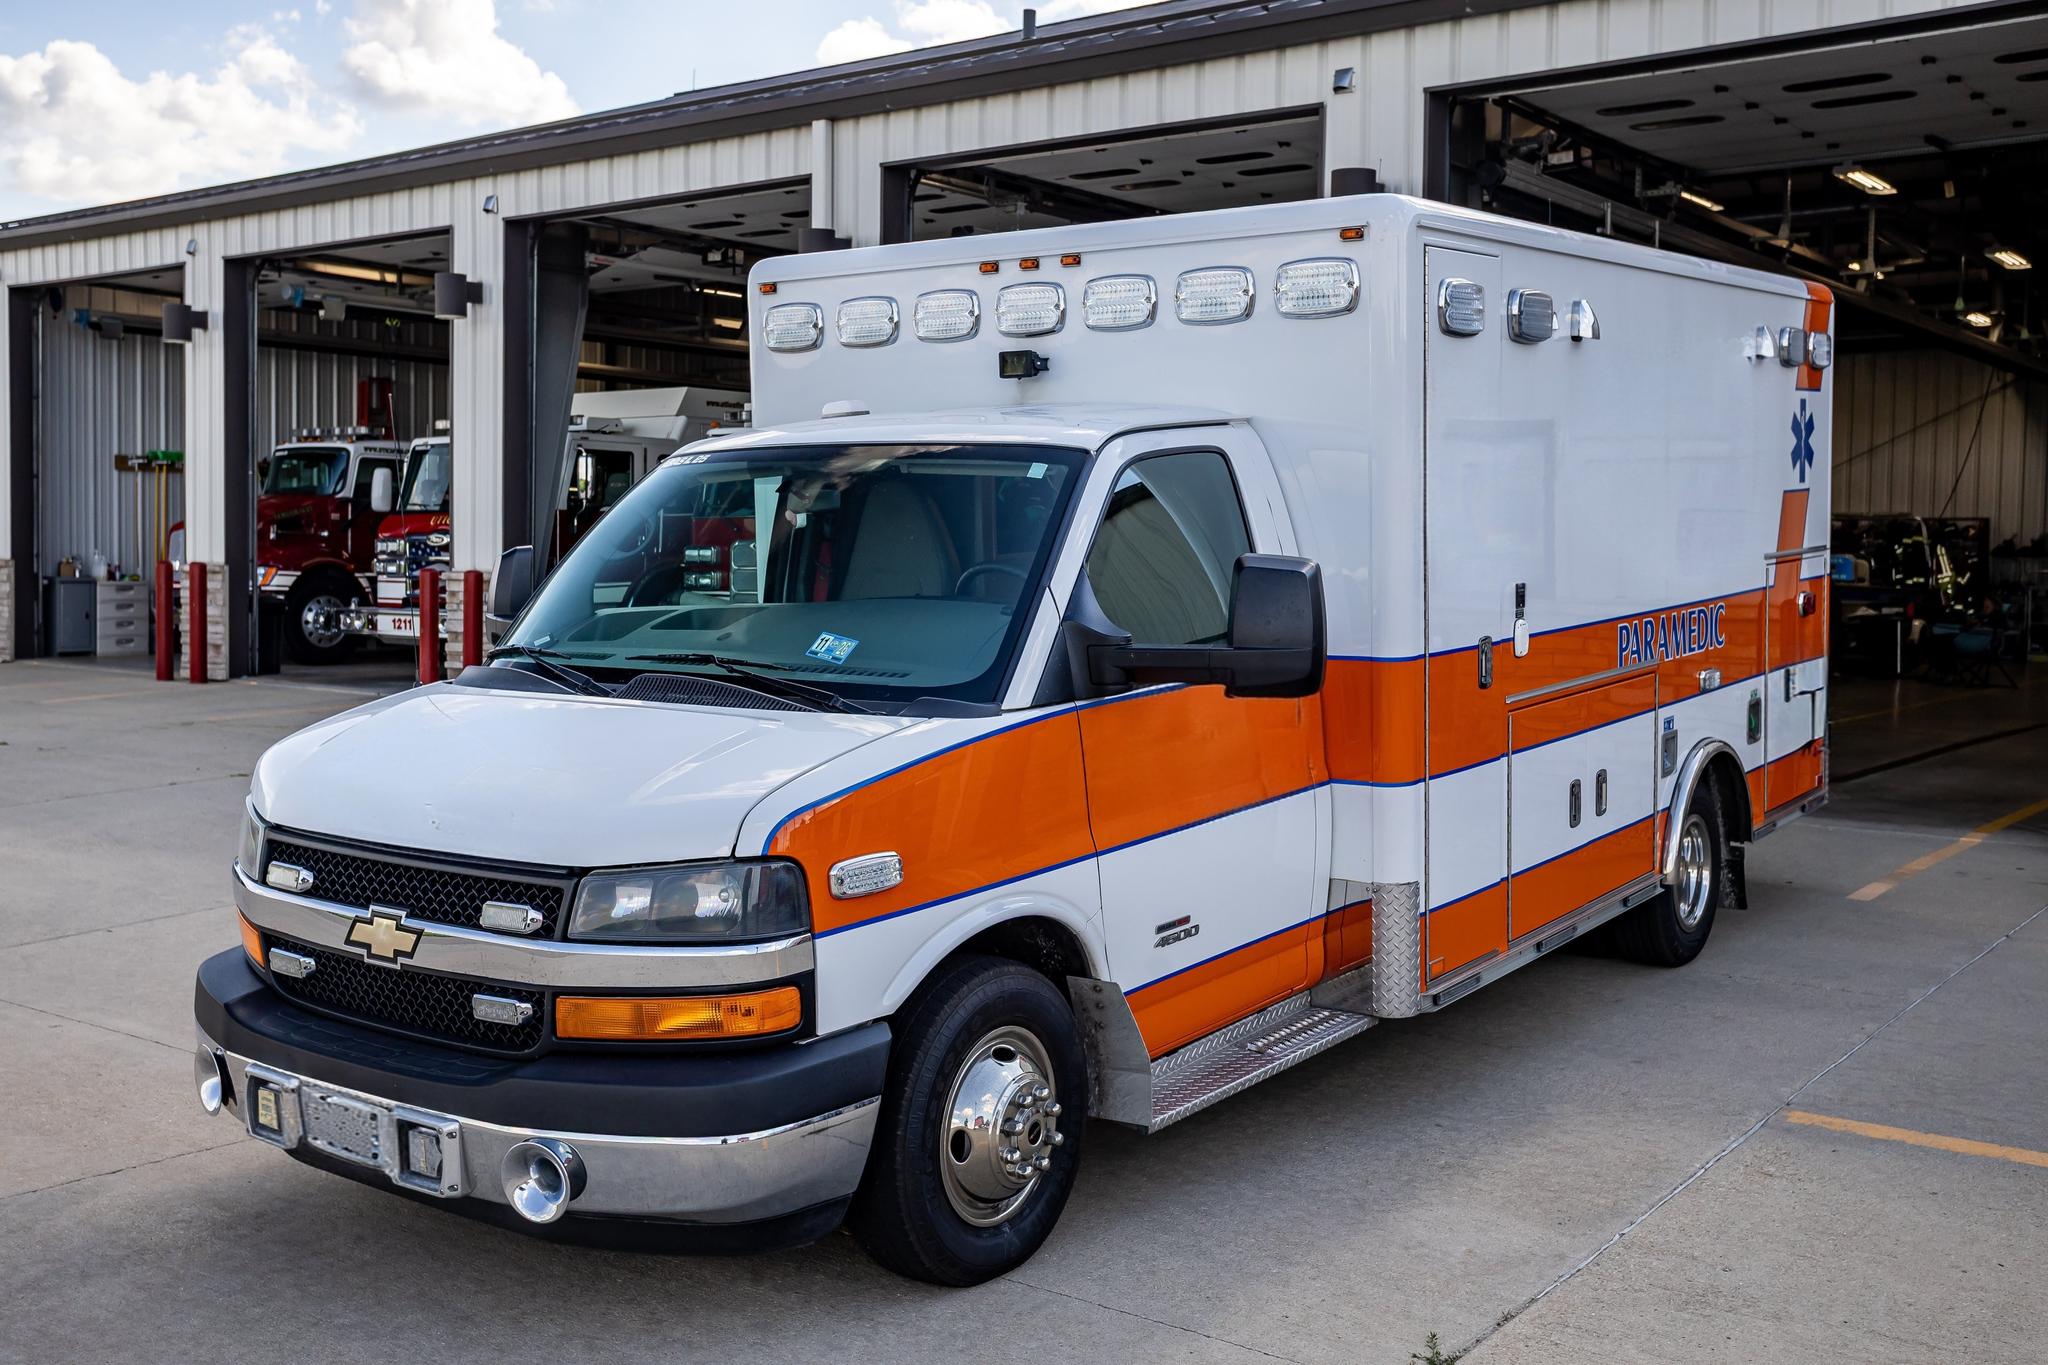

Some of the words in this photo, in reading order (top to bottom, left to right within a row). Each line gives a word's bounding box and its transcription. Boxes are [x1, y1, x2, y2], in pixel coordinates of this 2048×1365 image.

[391, 618, 412, 630] 1211
[815, 636, 831, 650] 11
[1617, 602, 1725, 668] PARAMEDIC
[1153, 924, 1200, 948] 4500
